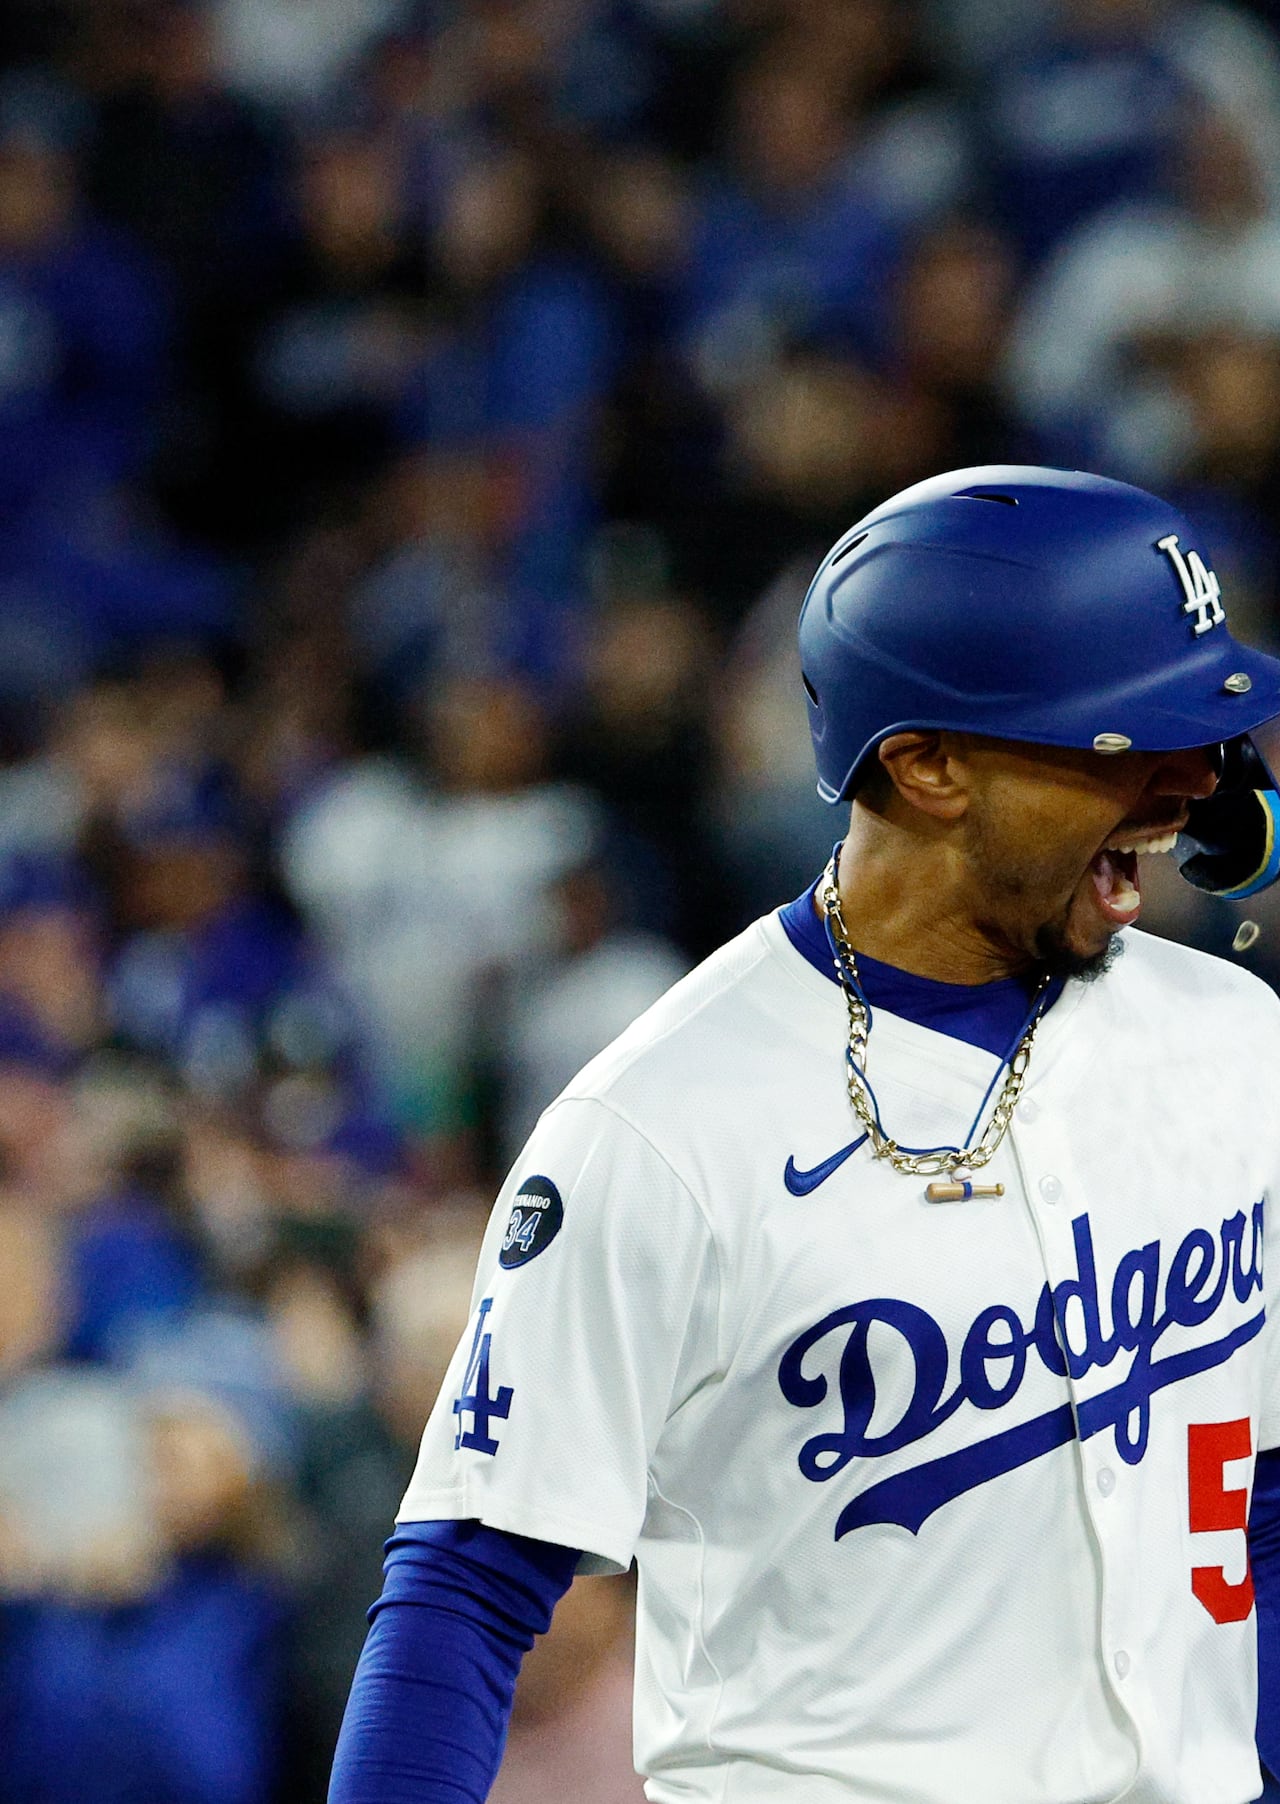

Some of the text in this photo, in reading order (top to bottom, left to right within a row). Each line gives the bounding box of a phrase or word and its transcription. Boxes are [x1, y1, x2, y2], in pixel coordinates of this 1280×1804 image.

[1156, 534, 1226, 634] LA
[502, 1208, 542, 1252] 34
[452, 1296, 515, 1456] LA
[1187, 1416, 1256, 1625] 5
